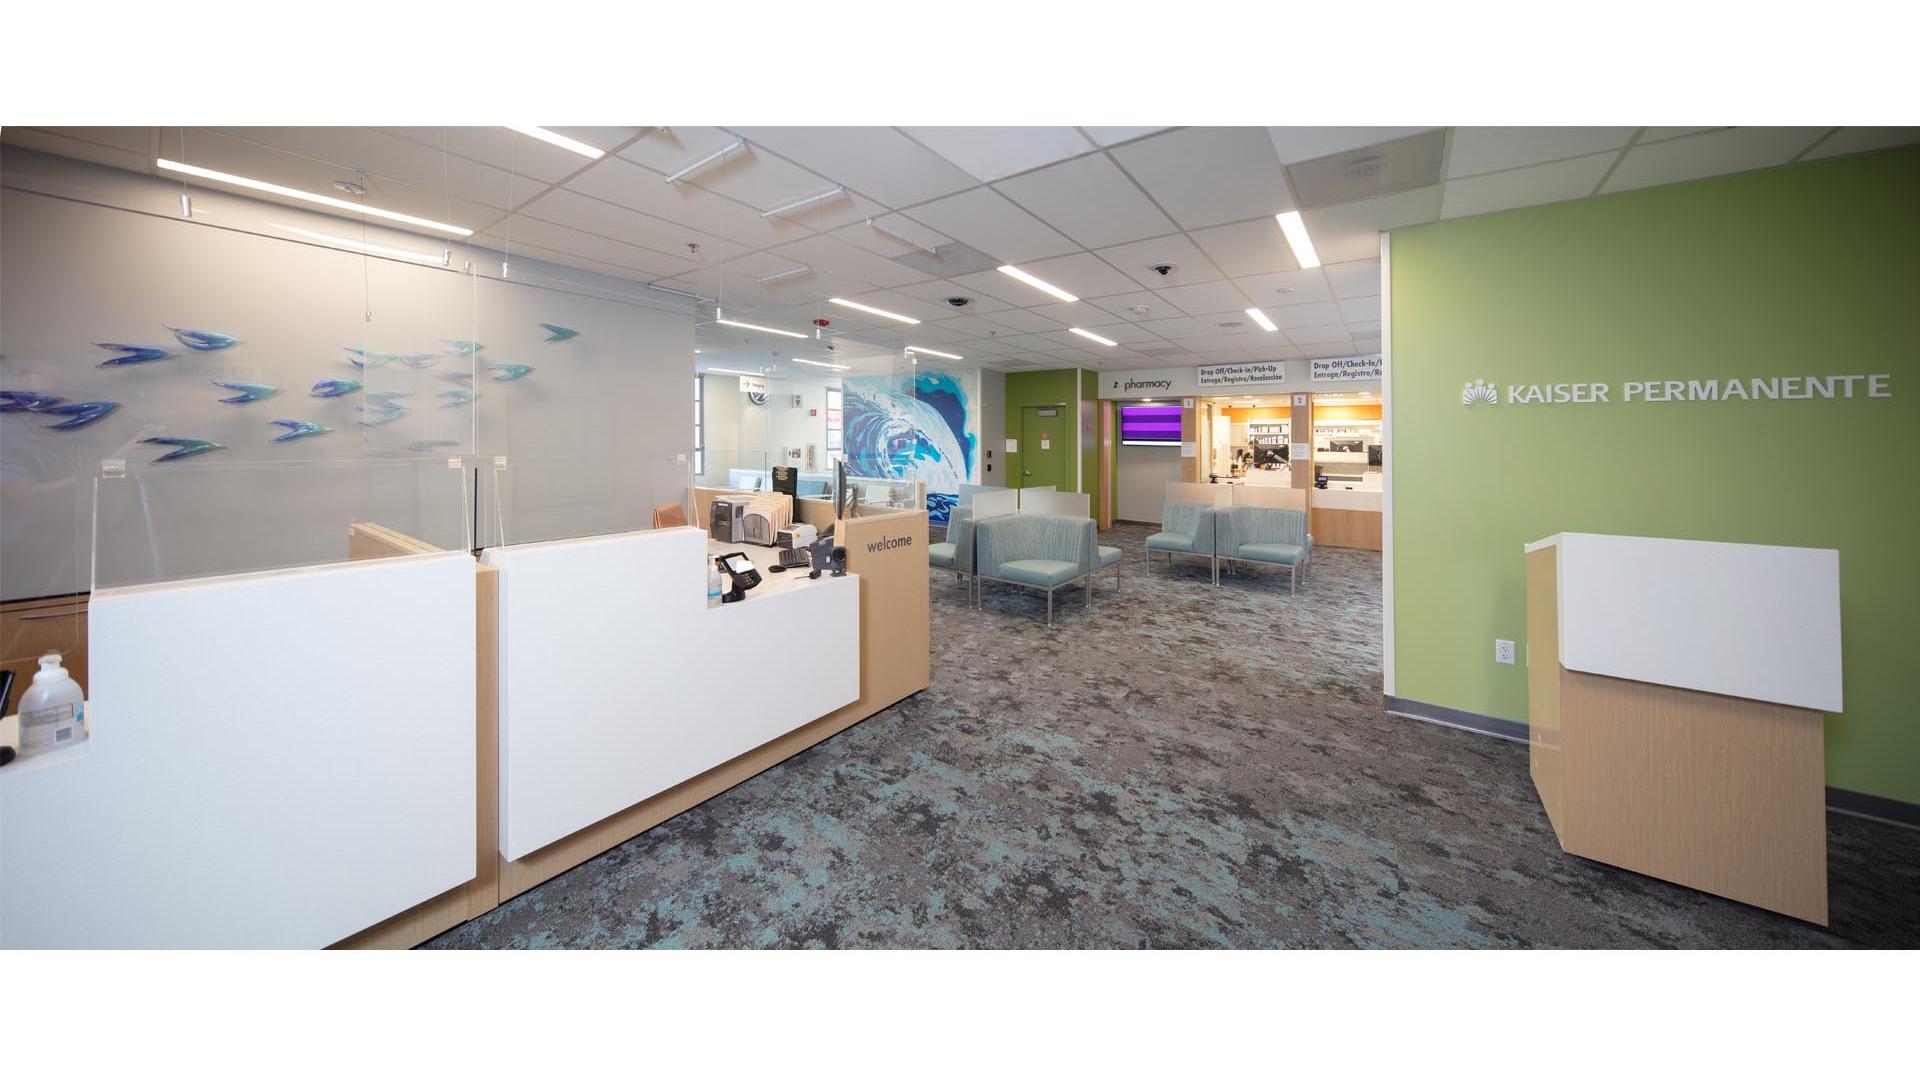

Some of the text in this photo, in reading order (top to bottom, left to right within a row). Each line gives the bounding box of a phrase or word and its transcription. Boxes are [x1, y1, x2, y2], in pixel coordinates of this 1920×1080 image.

[1124, 378, 1172, 392] pharmacy
[1508, 373, 1892, 404] KAISER PERMANENTE
[867, 535, 912, 553] welcome
